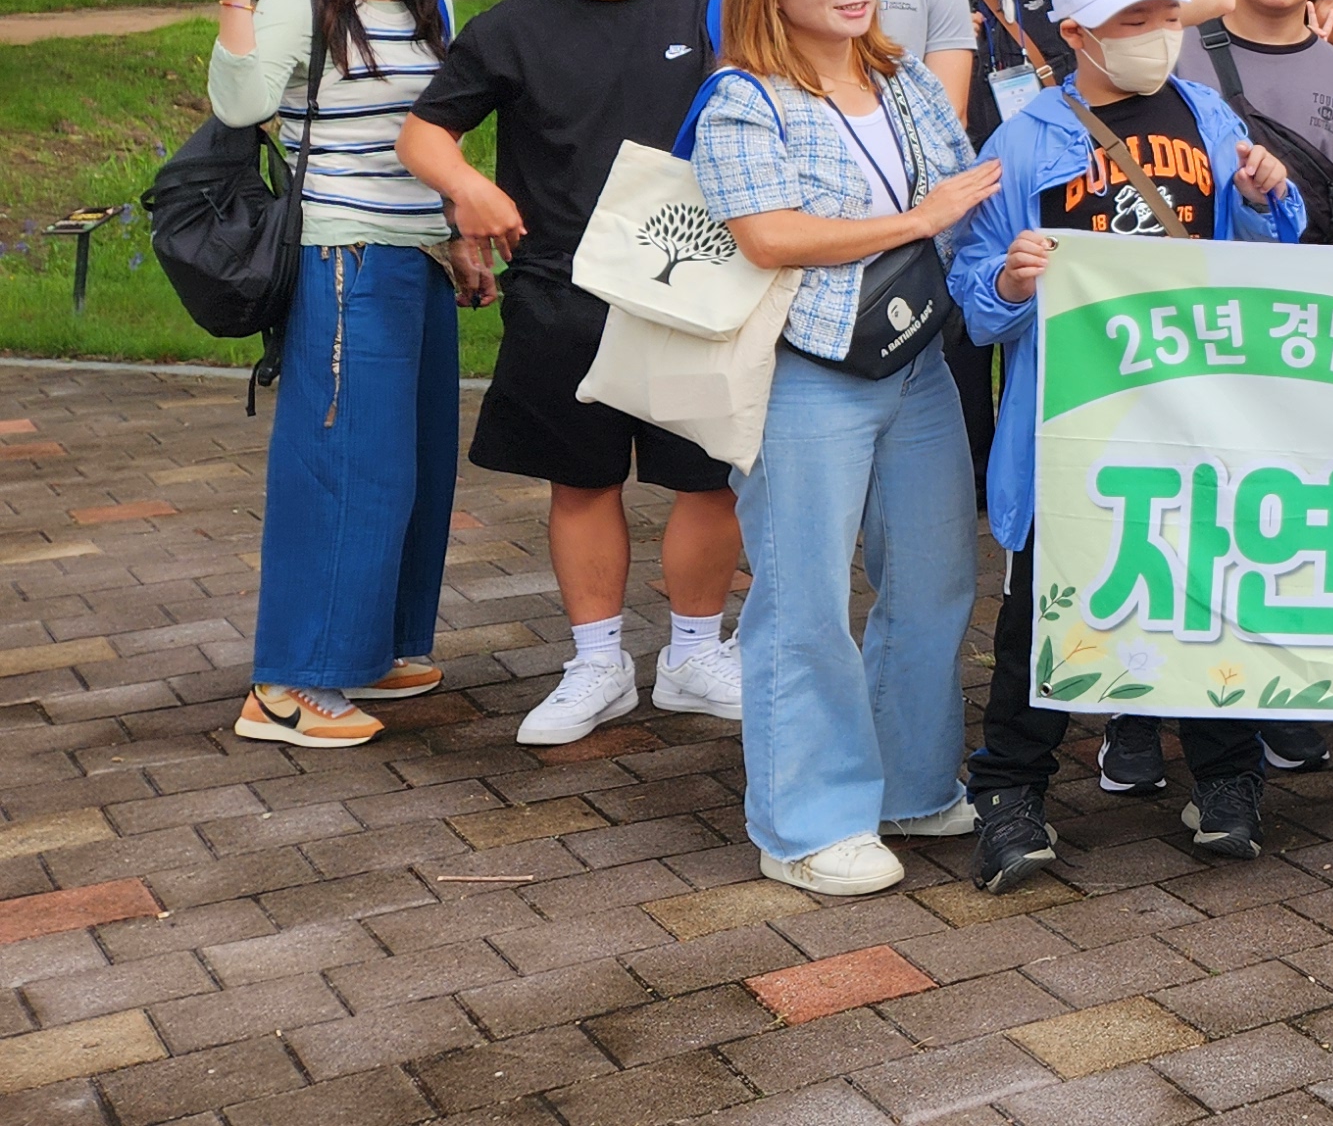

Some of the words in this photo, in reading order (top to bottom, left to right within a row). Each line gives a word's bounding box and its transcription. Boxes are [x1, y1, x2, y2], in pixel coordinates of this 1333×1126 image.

[1091, 214, 1107, 231] 18
[1177, 206, 1193, 222] 76
[1105, 300, 1246, 376] 25년
